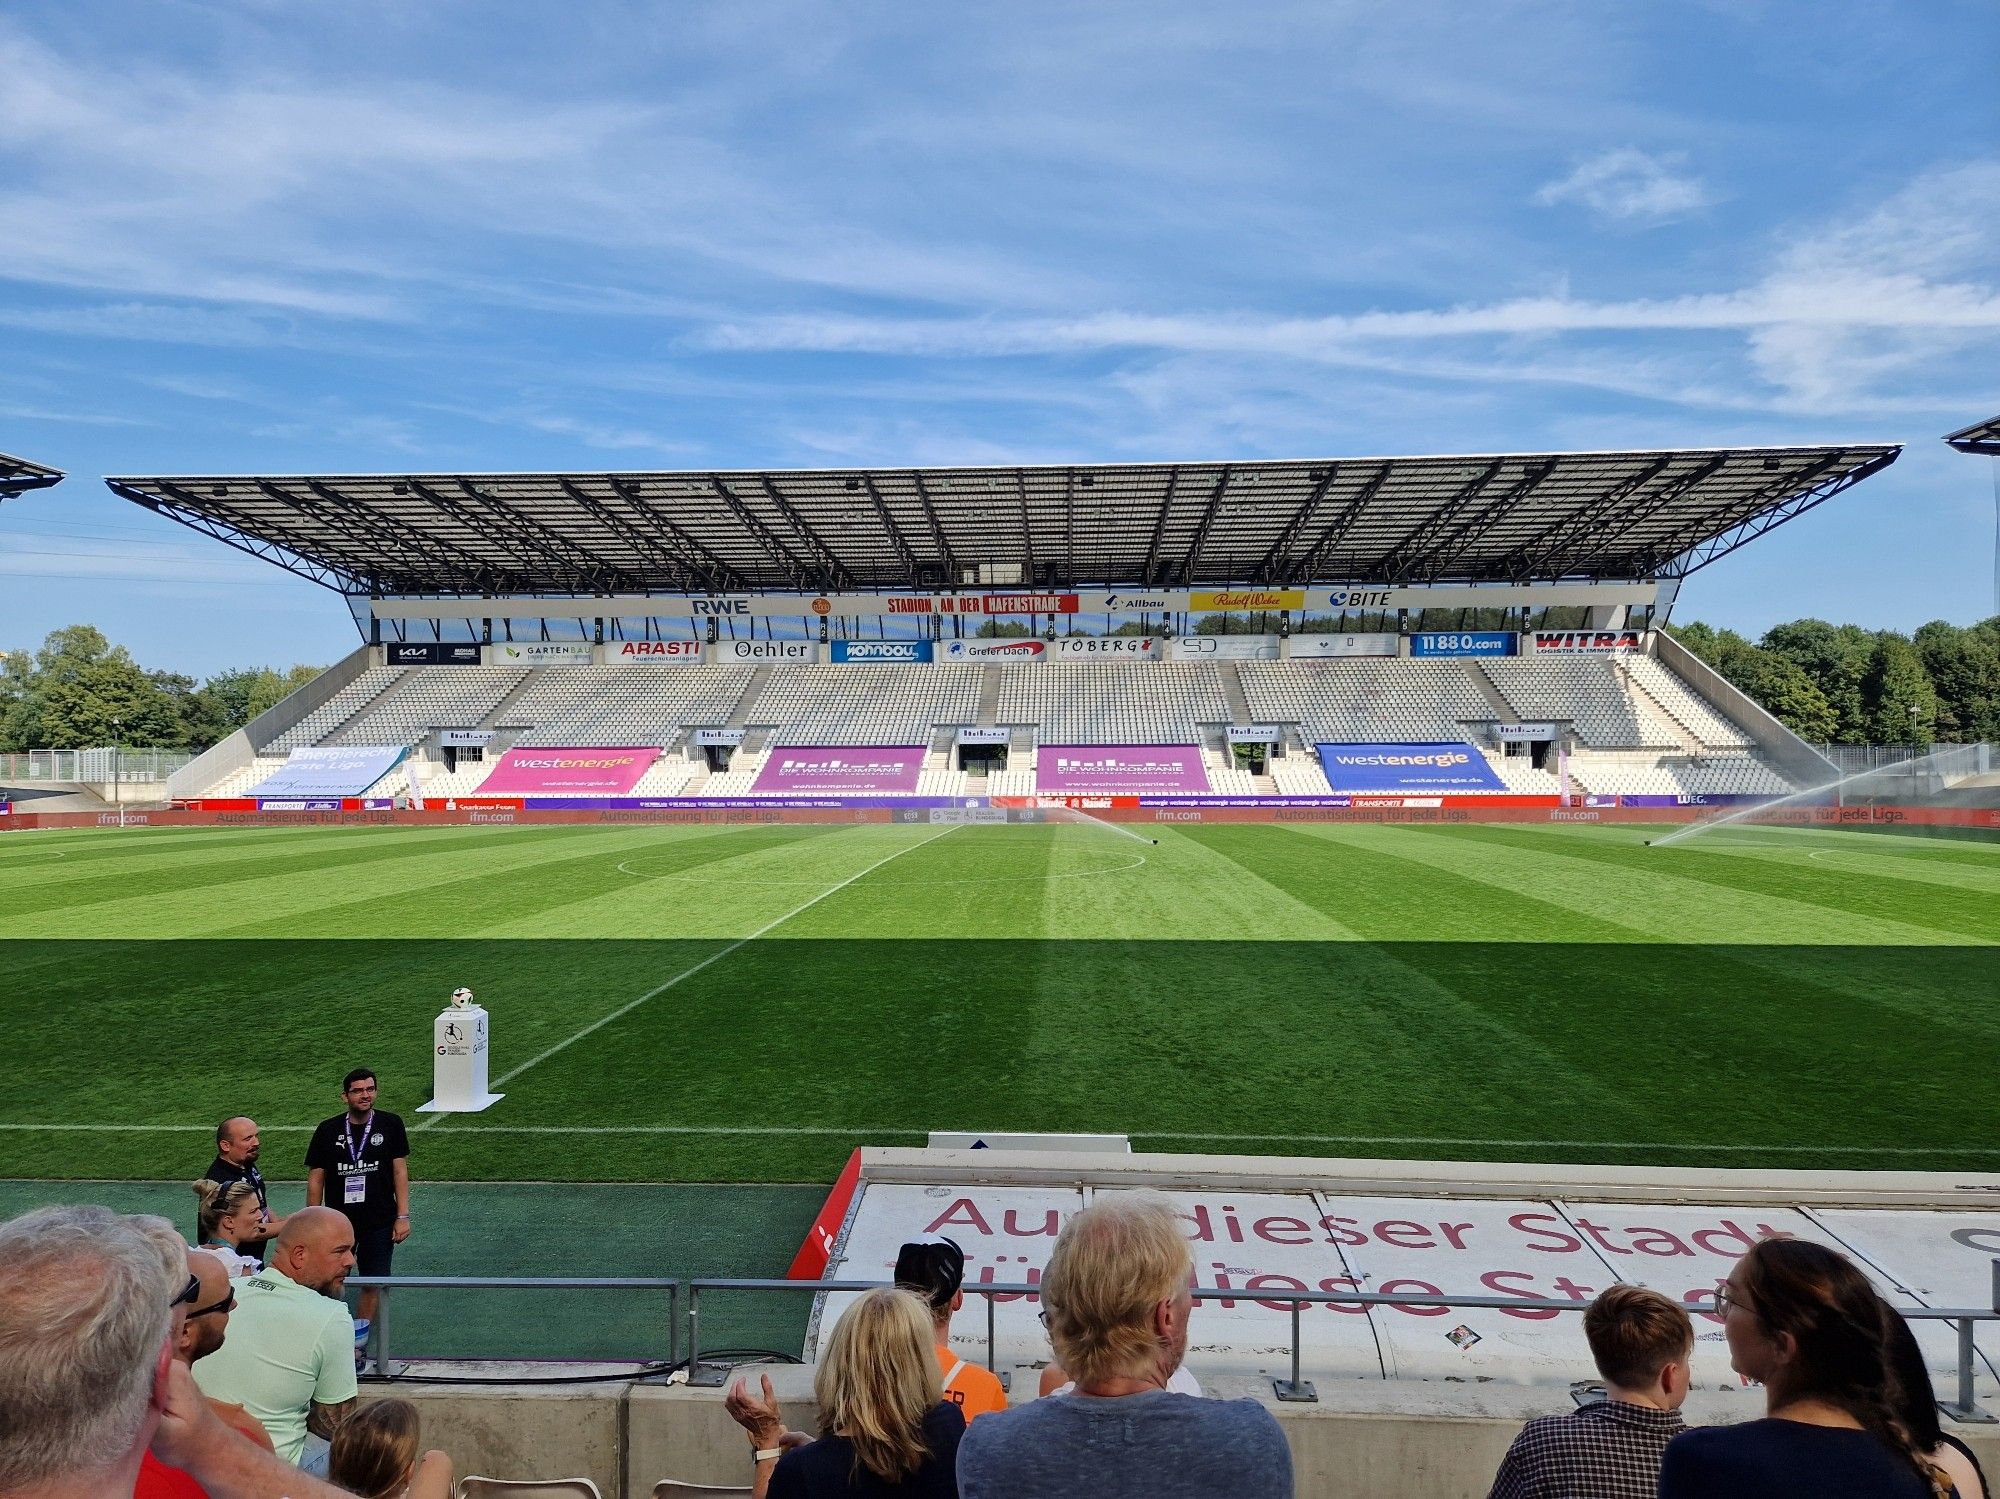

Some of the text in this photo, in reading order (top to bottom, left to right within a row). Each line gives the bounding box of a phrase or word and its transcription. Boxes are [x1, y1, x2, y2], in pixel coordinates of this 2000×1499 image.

[888, 599, 932, 613] STADION
[940, 598, 954, 612] AN
[959, 597, 980, 612] DER
[1125, 600, 1165, 608] Allbau
[1349, 592, 1392, 606] BITE
[692, 600, 750, 614] RWE
[1060, 638, 1137, 652] TÖBERG
[1536, 632, 1639, 648] WITRA
[621, 642, 700, 655] ARASTI
[735, 641, 808, 657] Oehler
[969, 647, 1001, 656] Grefer
[1003, 647, 1029, 656] Dach
[513, 756, 635, 769] westenergie
[1336, 752, 1470, 767] westenergie
[98, 813, 147, 824] ifmcom
[216, 811, 398, 825] Automatisierung für jede Liga.
[470, 812, 514, 822] ifm.com
[599, 809, 783, 823] Automatisierung für jede Liga.
[1155, 809, 1201, 820] ifm.com
[1274, 808, 1472, 822] Automatisierung für jede Liga.
[1550, 809, 1599, 820] ifm.com
[1815, 807, 1835, 820] für
[1837, 808, 1868, 823] jede
[1873, 808, 1908, 822] Liga.
[923, 1198, 1059, 1237] Au
